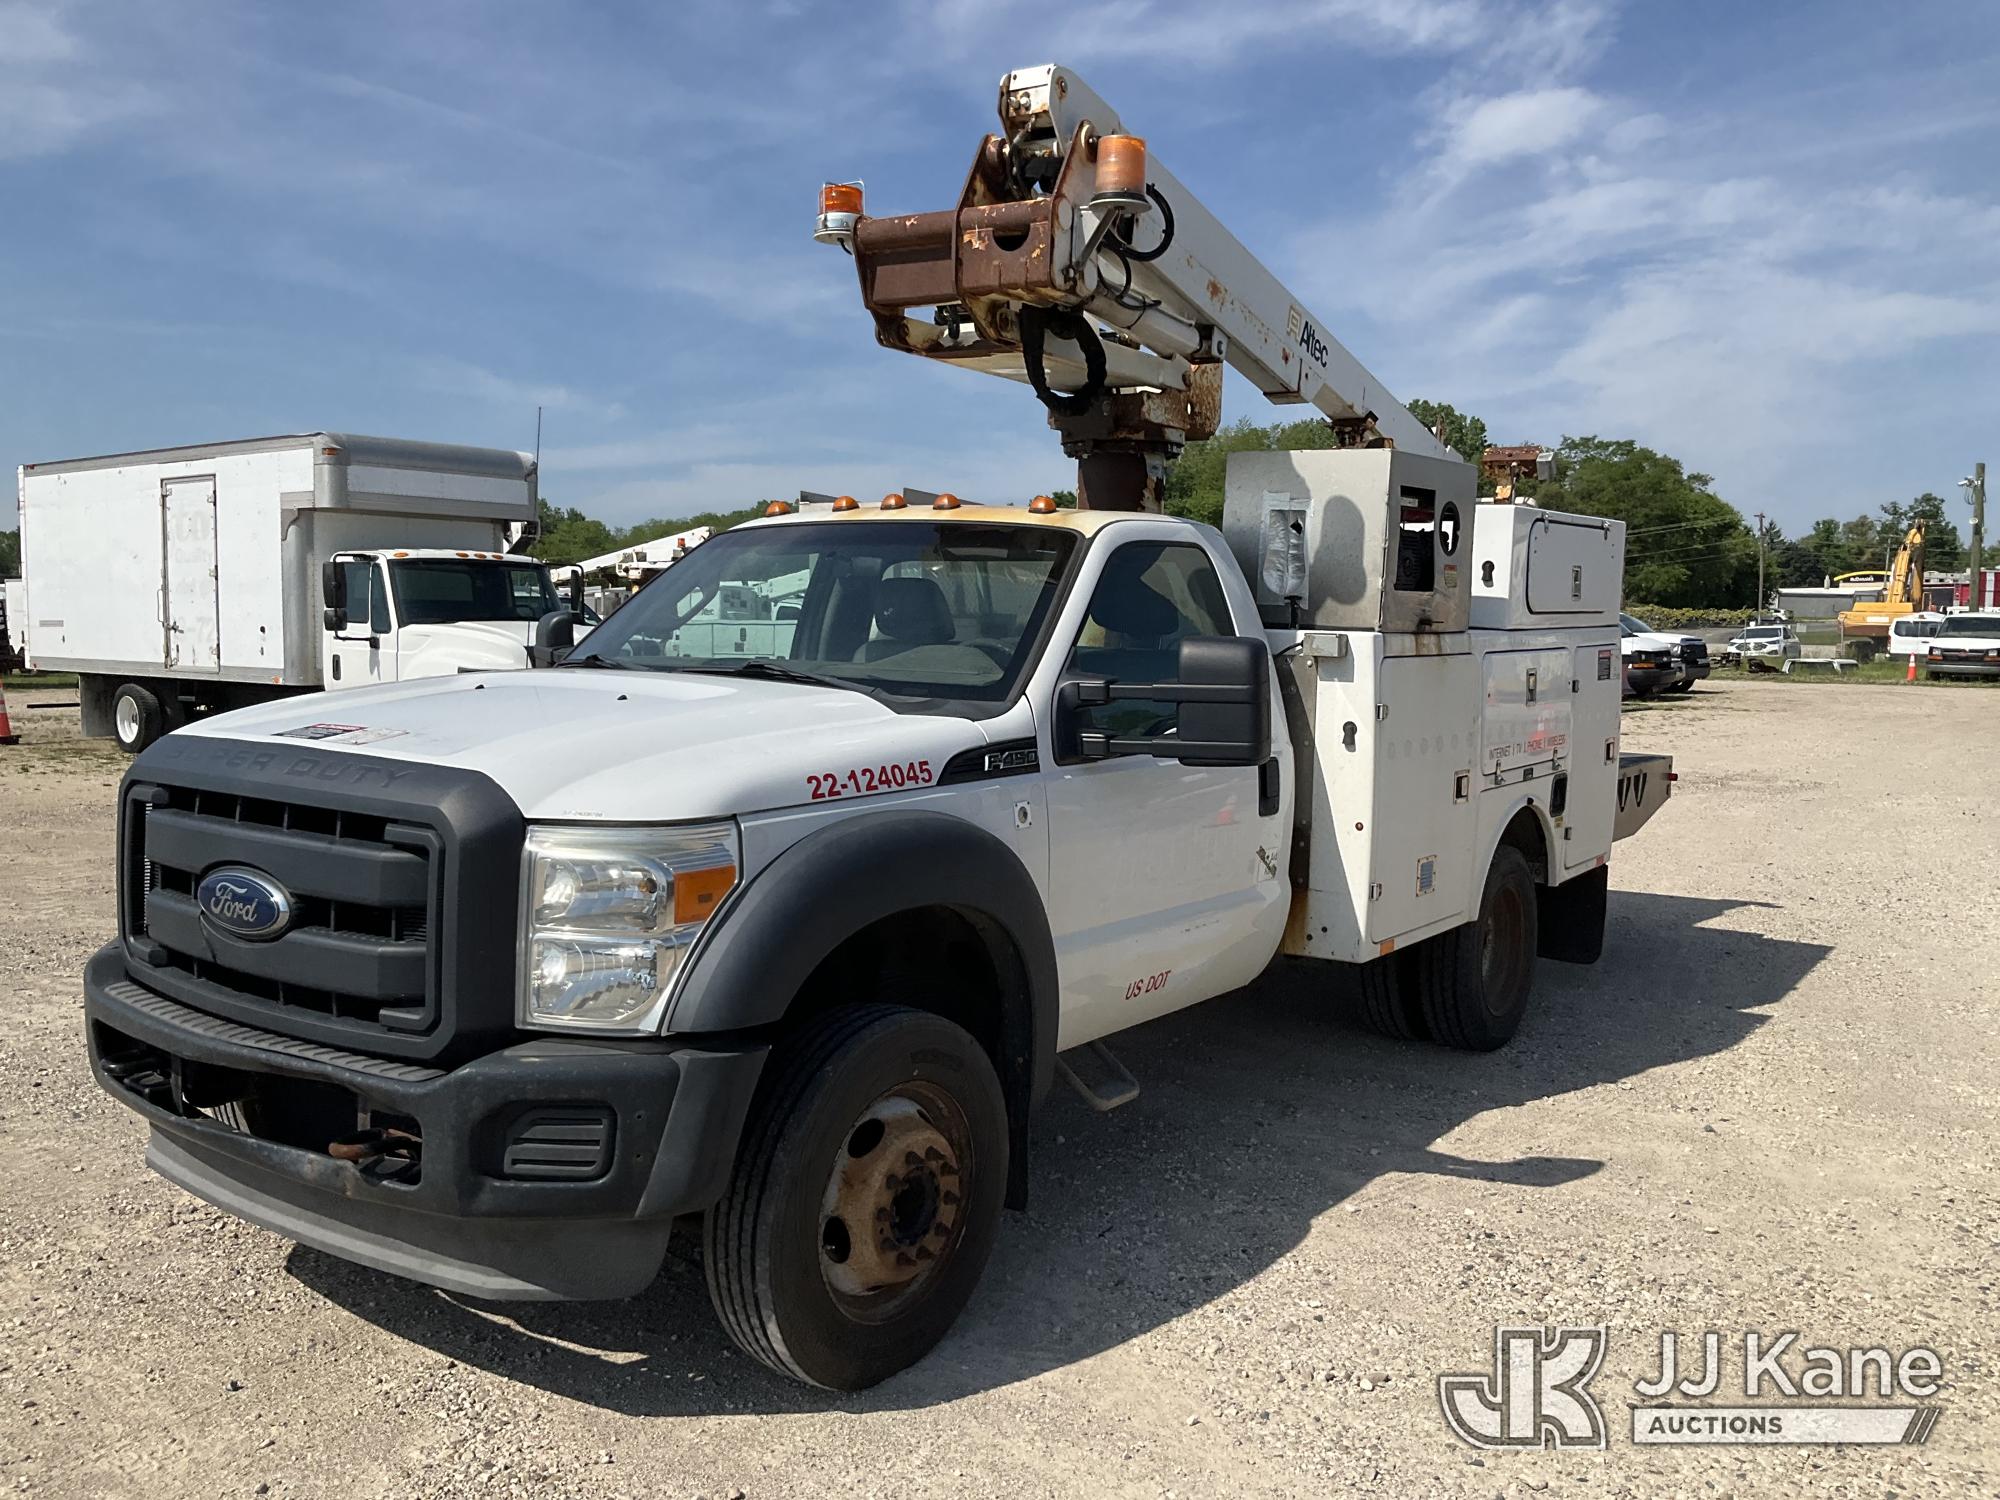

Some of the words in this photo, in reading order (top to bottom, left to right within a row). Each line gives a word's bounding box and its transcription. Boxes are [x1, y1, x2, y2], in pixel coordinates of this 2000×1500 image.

[1299, 320, 1328, 368] Altec
[283, 755, 417, 788] DUTY
[806, 760, 933, 800] 22-124045
[211, 881, 259, 922] Ford
[1125, 979, 1144, 1001] US
[1145, 969, 1172, 993] DOT
